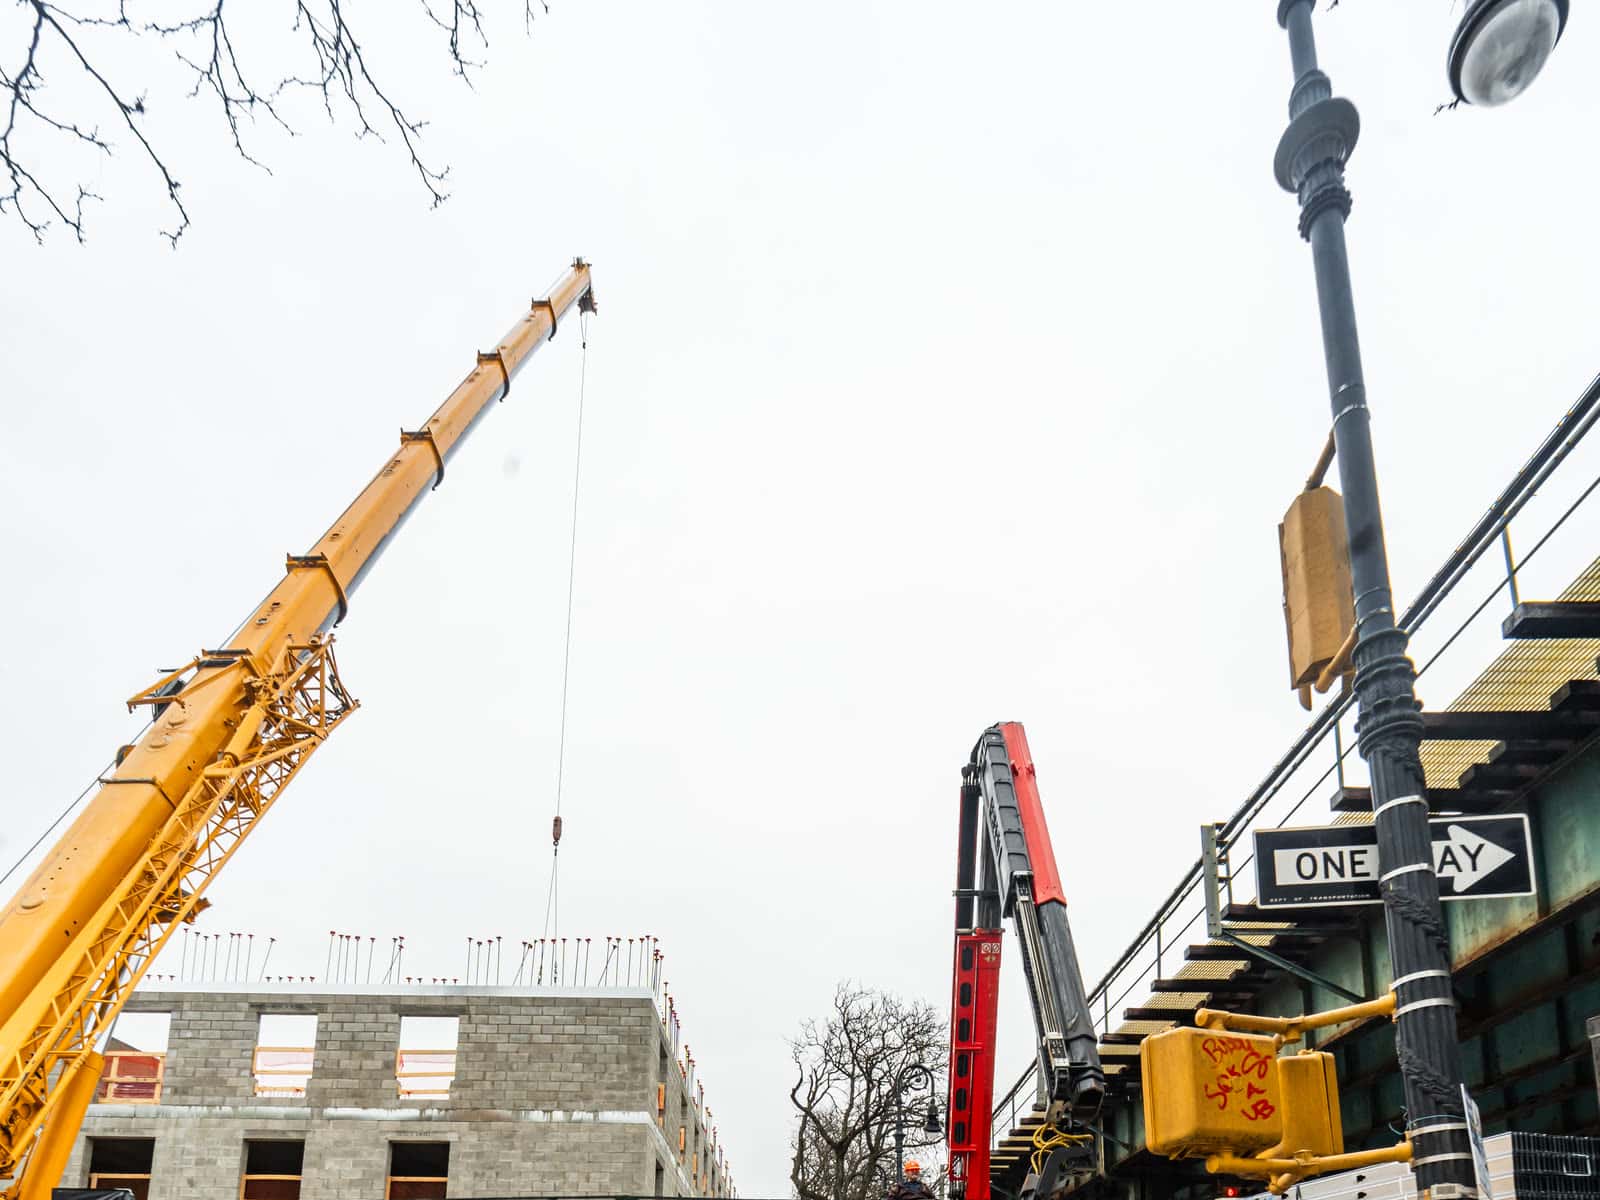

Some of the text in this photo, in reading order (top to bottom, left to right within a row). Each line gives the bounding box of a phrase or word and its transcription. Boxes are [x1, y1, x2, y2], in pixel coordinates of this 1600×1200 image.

[1295, 843, 1485, 881] ONE AY
[1309, 893, 1371, 901] TRANSPORTATION
